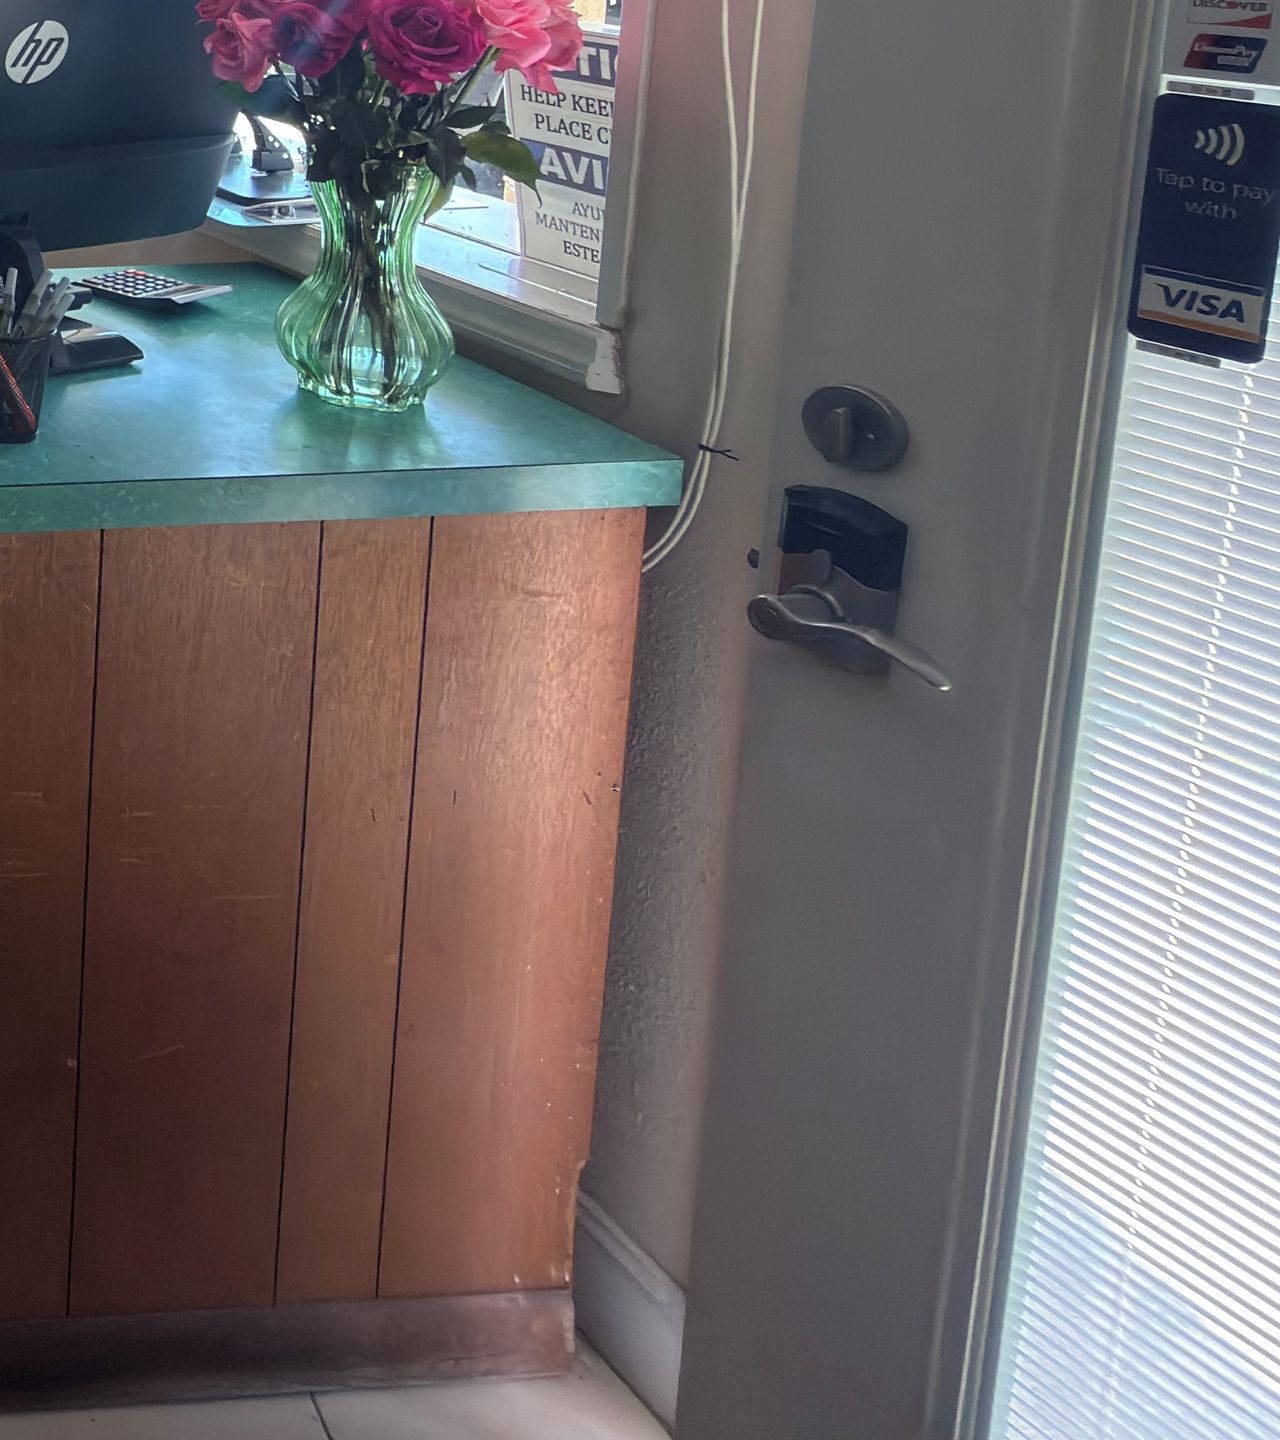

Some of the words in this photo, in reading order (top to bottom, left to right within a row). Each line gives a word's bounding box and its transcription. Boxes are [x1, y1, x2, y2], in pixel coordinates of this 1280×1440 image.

[9, 21, 66, 84] hp
[520, 83, 567, 109] HELP
[572, 92, 614, 118] KEE
[534, 112, 593, 142] PLACE
[597, 127, 612, 145] C
[1153, 167, 1195, 191] Tap
[1200, 177, 1226, 193] to
[1231, 183, 1274, 205] pay
[535, 211, 604, 242] MANTEN
[571, 200, 605, 222] AYU
[1184, 201, 1238, 220] with
[562, 240, 600, 264] ESTE
[1152, 282, 1245, 323] VISA
